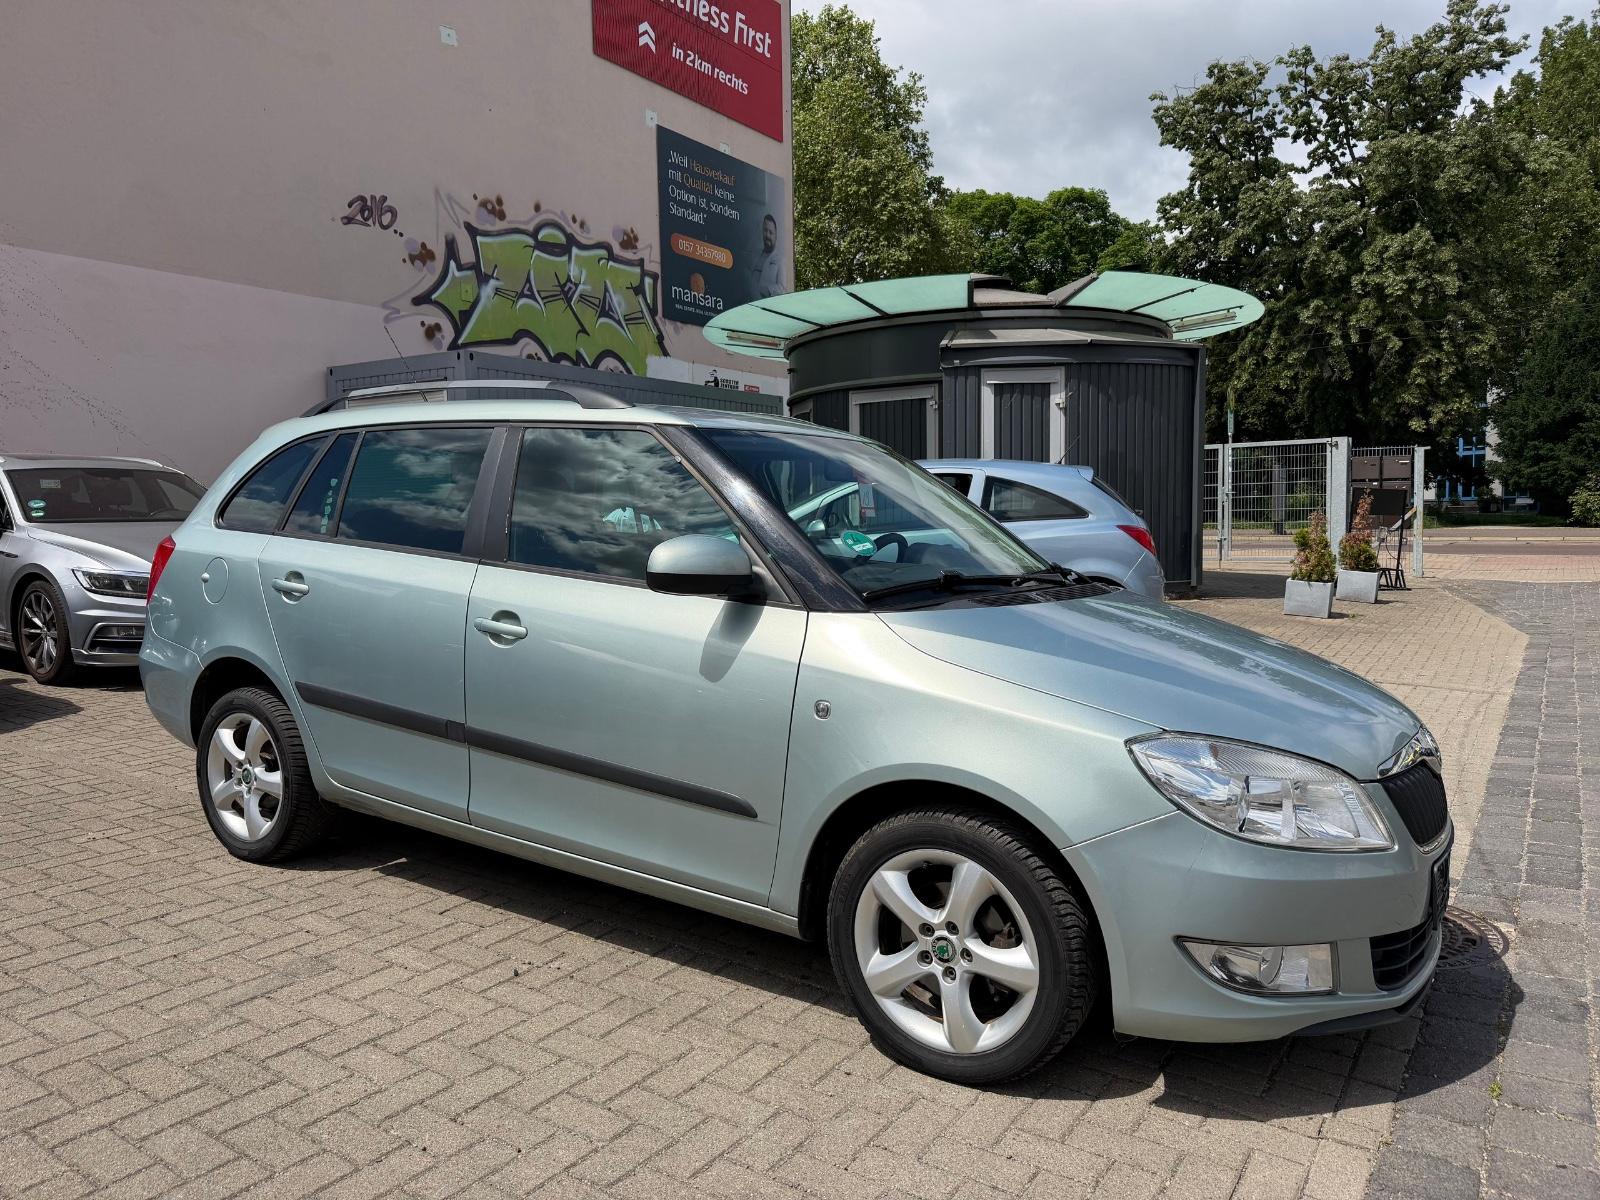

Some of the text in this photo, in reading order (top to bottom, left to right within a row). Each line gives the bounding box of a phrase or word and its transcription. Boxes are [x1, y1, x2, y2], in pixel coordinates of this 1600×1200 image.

[660, 0, 772, 58] ness First
[672, 42, 684, 62] in
[714, 67, 748, 95] rechts
[668, 169, 682, 183] mit
[714, 184, 735, 203] keine
[690, 159, 736, 187] Hausverkauf
[668, 184, 740, 221] Option ist, sondern
[678, 239, 694, 254] 0157
[671, 285, 723, 310] mansara
